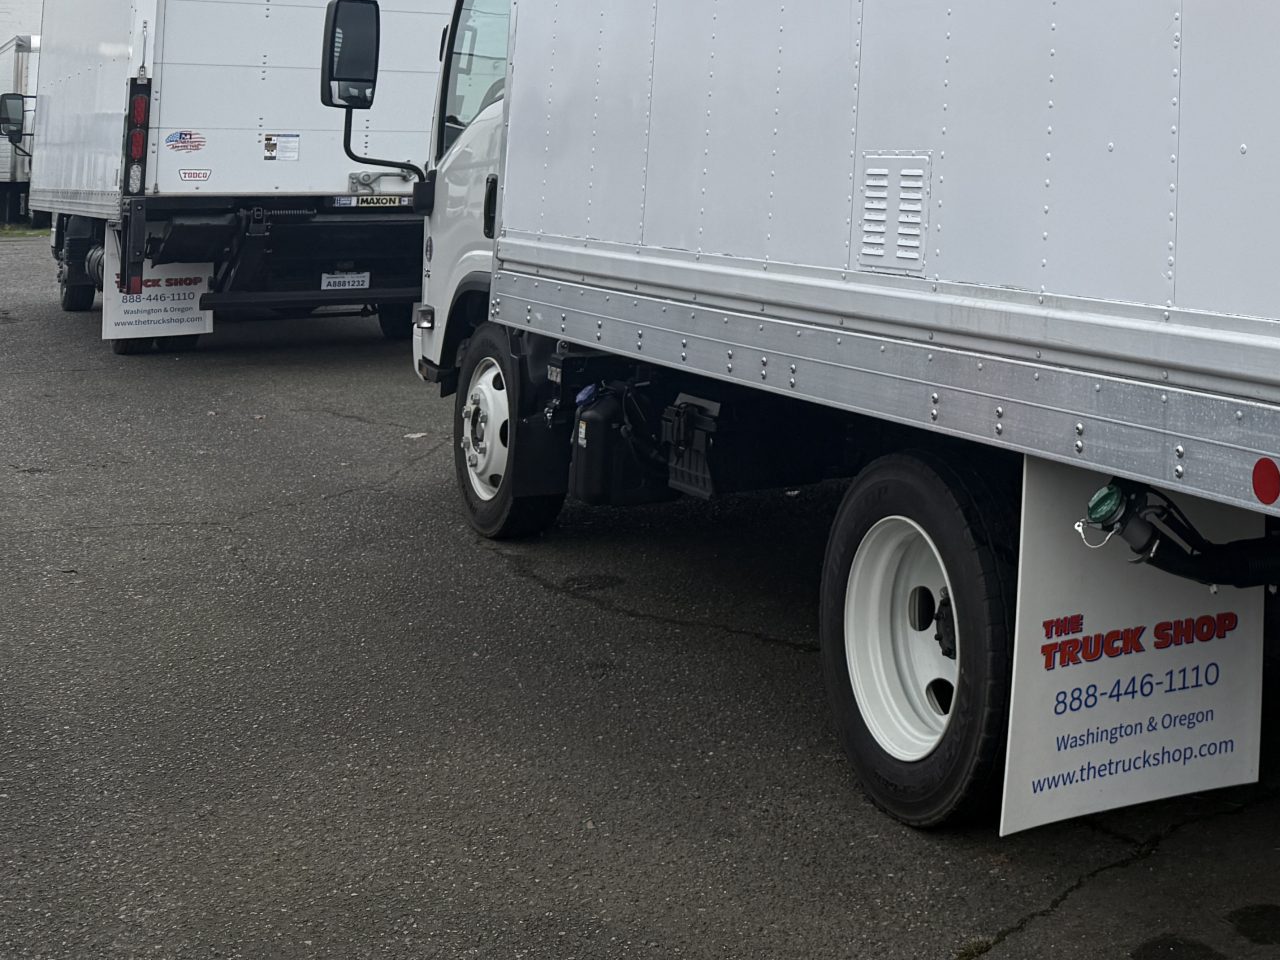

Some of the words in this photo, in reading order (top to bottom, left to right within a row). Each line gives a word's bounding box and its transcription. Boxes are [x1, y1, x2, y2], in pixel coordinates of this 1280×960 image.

[182, 171, 208, 179] TODCO
[360, 197, 397, 205] MAXON
[165, 276, 203, 288] SHOP
[121, 291, 195, 304] 888-446-1110
[123, 307, 162, 316] Washington
[169, 305, 194, 314] Oregon
[113, 316, 203, 327] www.thetruckshop.com
[1042, 613, 1084, 639] THE
[1041, 625, 1147, 671] TRUCK
[1153, 611, 1239, 650] SHOP
[1053, 661, 1221, 716] 888-446-1110
[1055, 721, 1144, 752] Washington
[1146, 715, 1159, 733] &
[1161, 707, 1215, 731] Oregon
[1031, 738, 1235, 794] www.thetruckshop.com
